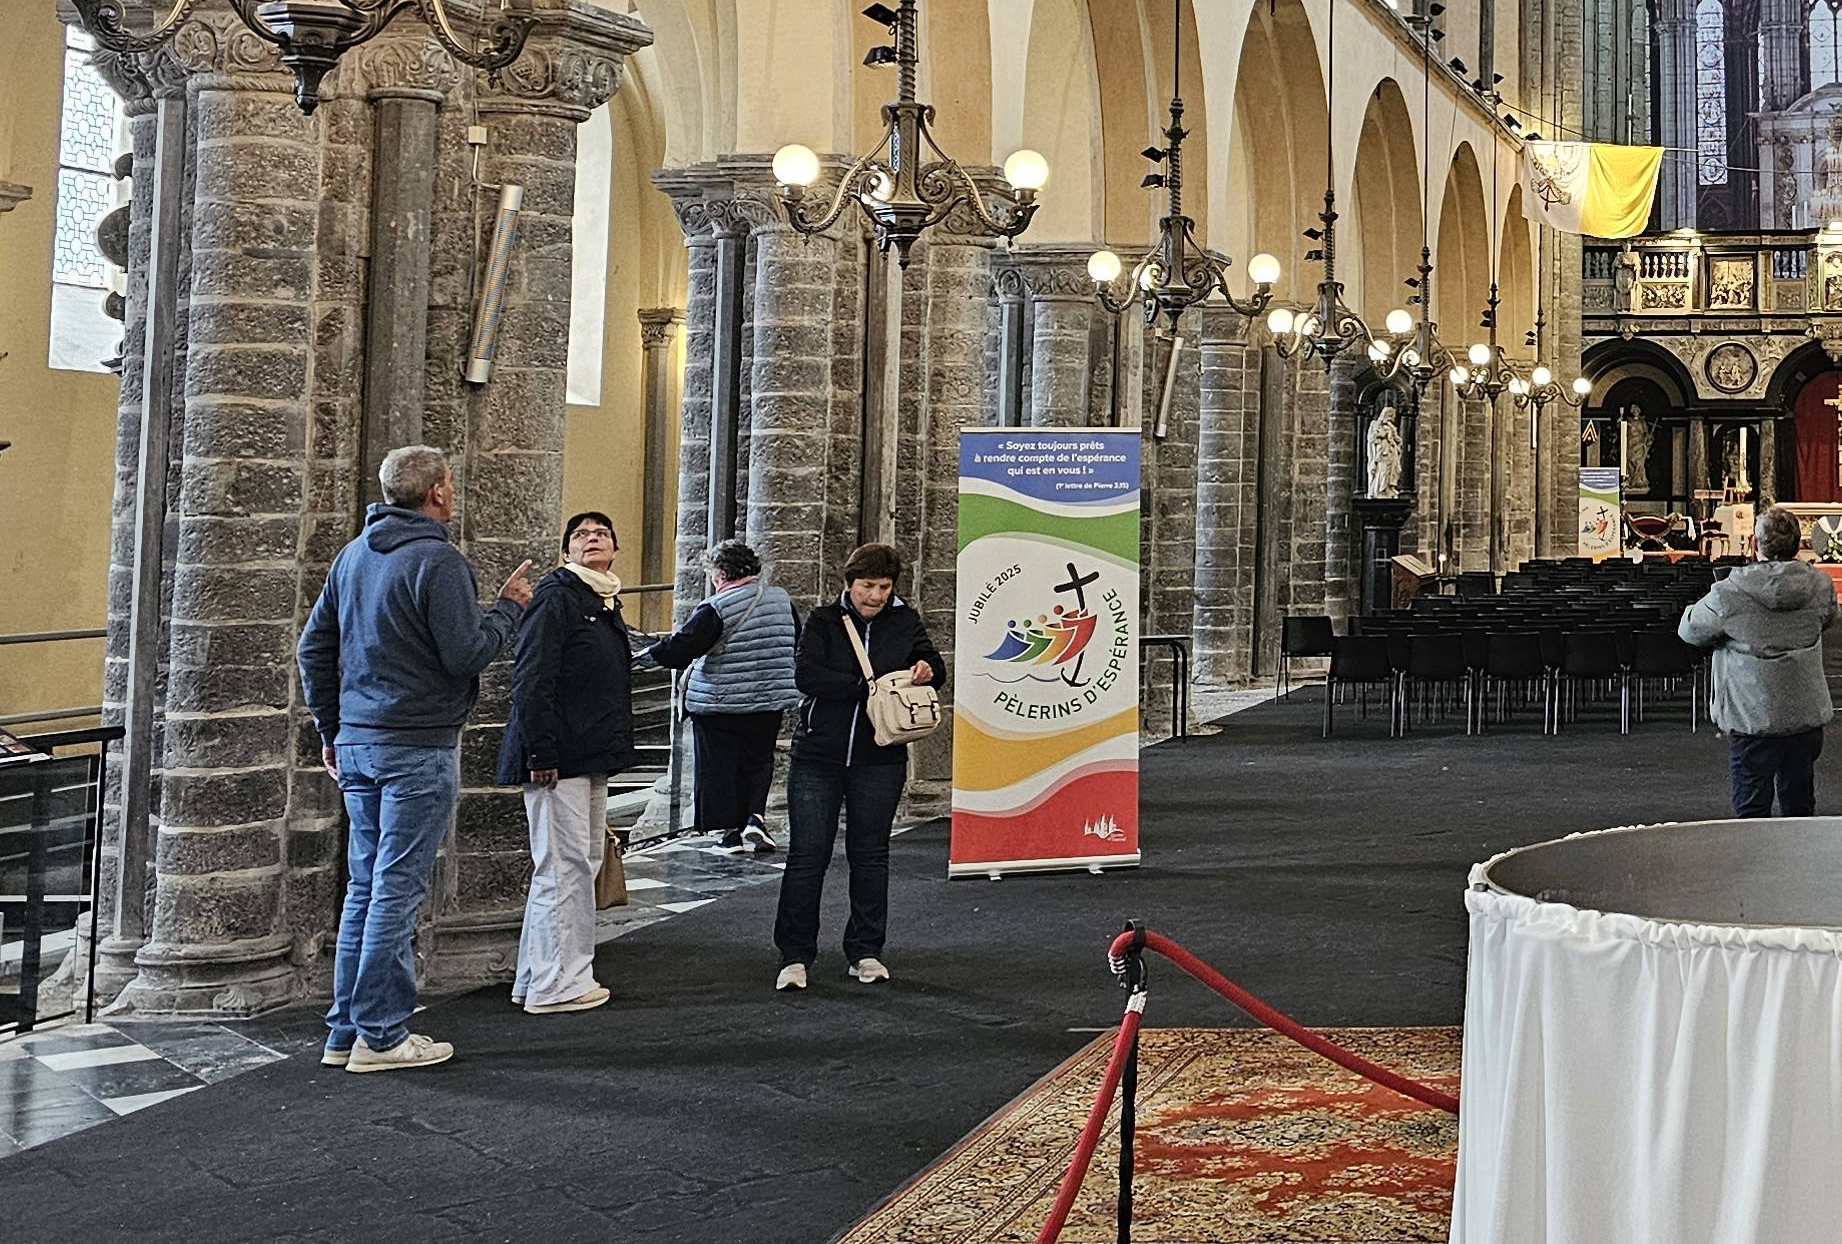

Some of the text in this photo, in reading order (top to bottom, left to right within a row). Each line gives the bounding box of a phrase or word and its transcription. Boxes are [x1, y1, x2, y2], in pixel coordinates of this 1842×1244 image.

[1006, 441, 1036, 452] Soyez
[1038, 441, 1078, 452] toujours
[1080, 441, 1105, 452] prêts
[974, 453, 1127, 465] à rendre compte de l'espérance
[1007, 466, 1024, 477] qui
[1025, 467, 1041, 475] est
[1043, 467, 1056, 475] en
[1057, 467, 1081, 475] vous
[1083, 482, 1093, 490] de
[1093, 482, 1114, 490] Pierre
[968, 563, 1022, 625] JUBILÉ 2025
[1083, 588, 1129, 705] D'ESPÉRANCE
